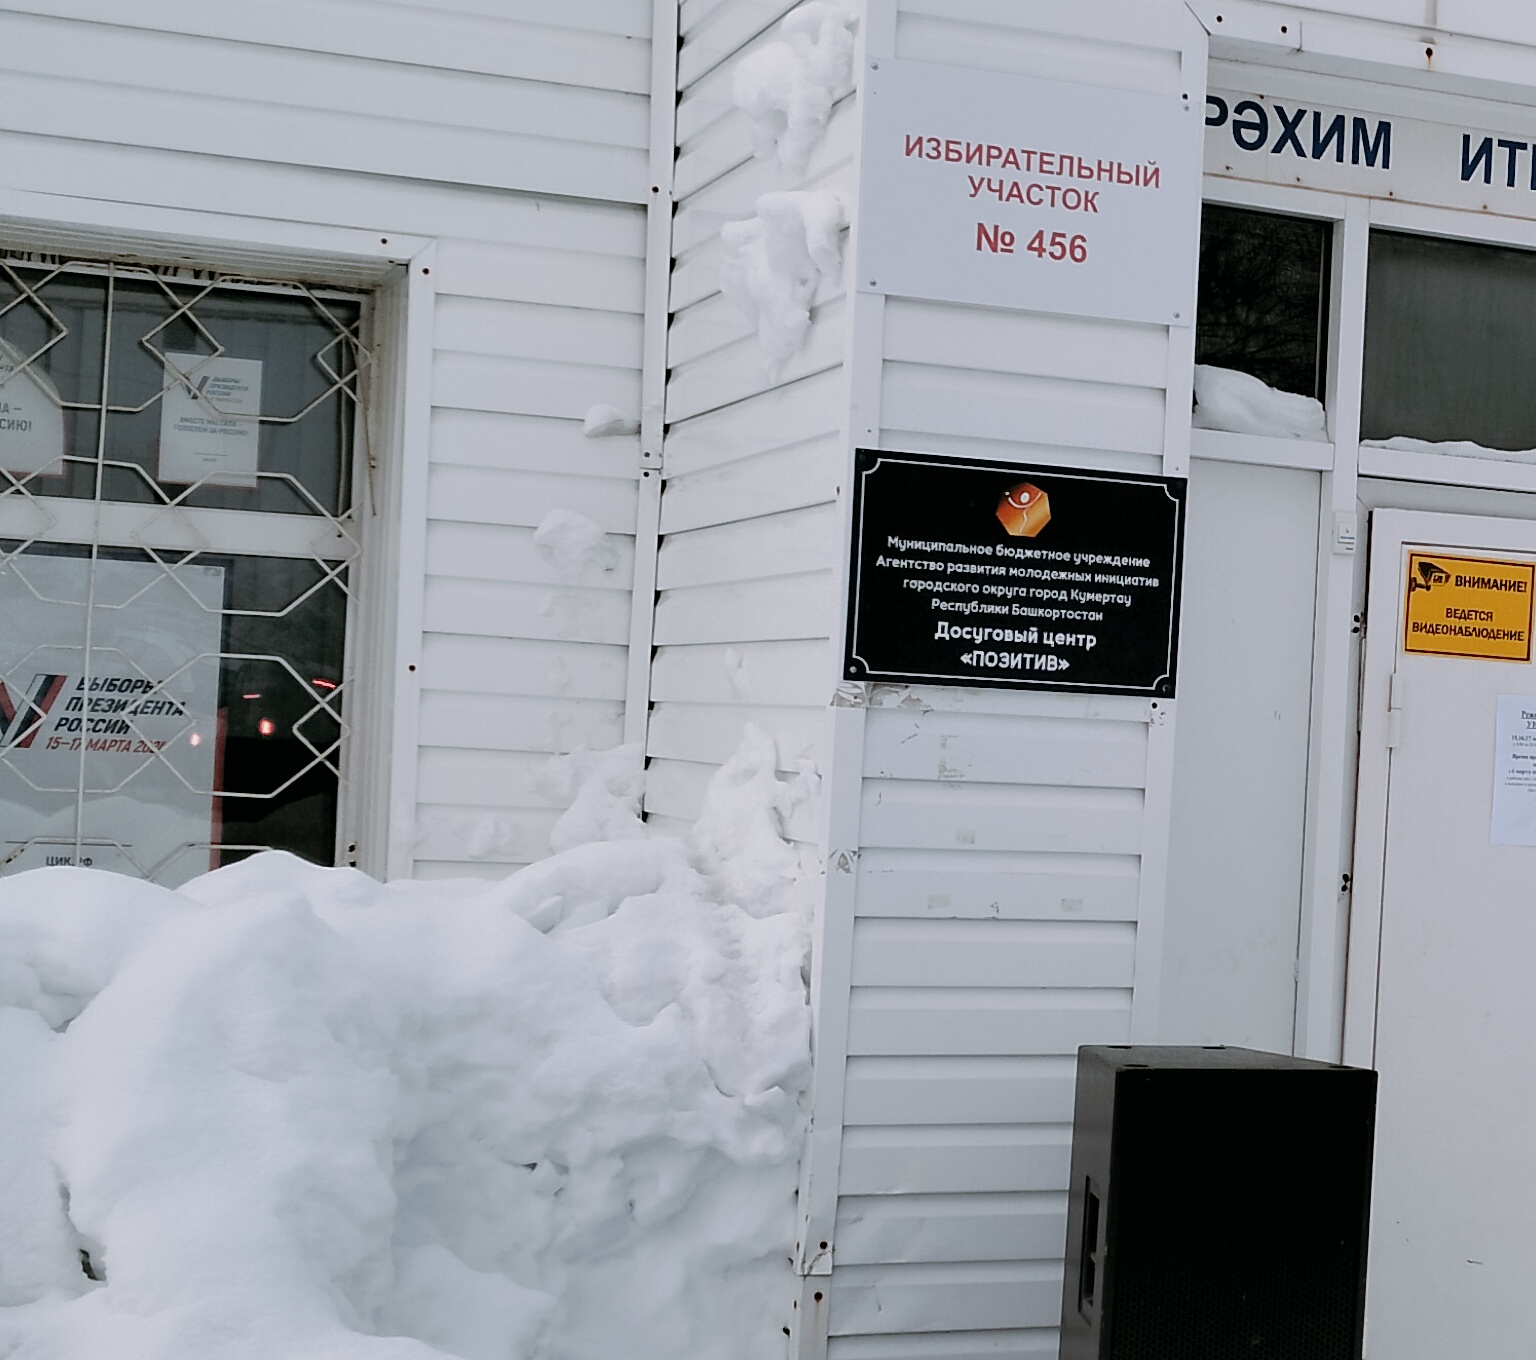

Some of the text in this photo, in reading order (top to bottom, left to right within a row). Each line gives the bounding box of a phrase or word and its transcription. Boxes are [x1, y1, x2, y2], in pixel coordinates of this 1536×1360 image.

[1205, 92, 1394, 171] РӘХИМ
[905, 134, 1160, 188] ИЗБИРАТЕЛЬНЫЙ
[968, 175, 1100, 213] УЧАСТОК
[976, 222, 1087, 263] № 456
[887, 536, 1151, 567] Муниципальное бюджетное учреждение
[876, 555, 1160, 588] Агентство развития молодежных инициатив
[1454, 575, 1527, 593] ВНИМАНИЕ!
[903, 579, 1131, 608] городского округа город Кумертау
[931, 599, 1103, 622] Республики Башкортостан
[1446, 608, 1493, 622] ВЕДЕТСЯ
[935, 622, 1097, 650] Досуговый центр
[1412, 622, 1524, 642] ВИДЕОНАБЛЮДЕНИЕ
[960, 650, 1070, 671] «ПОЗИТИВ»
[54, 717, 133, 734] РОССИИ
[86, 738, 131, 752] МАРТА
